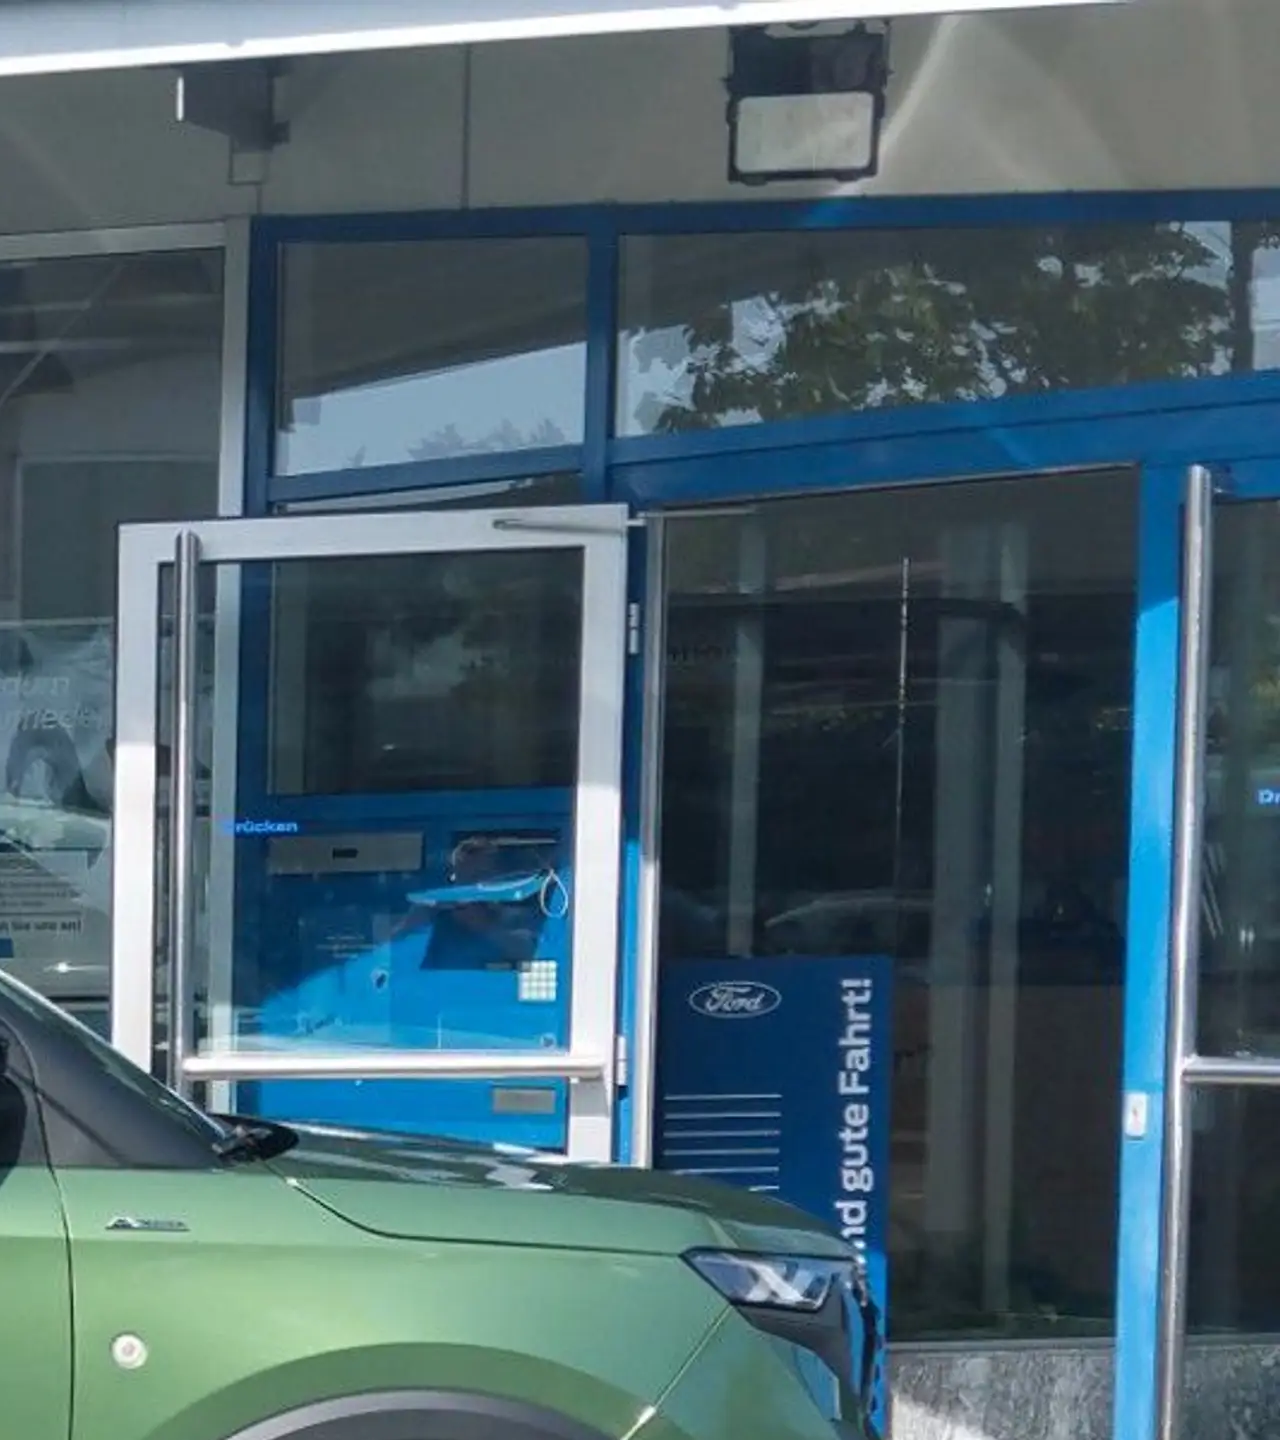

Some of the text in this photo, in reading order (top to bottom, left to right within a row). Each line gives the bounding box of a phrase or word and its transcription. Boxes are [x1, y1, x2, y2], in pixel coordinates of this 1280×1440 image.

[836, 978, 873, 1263] nd gute Fahrt!
